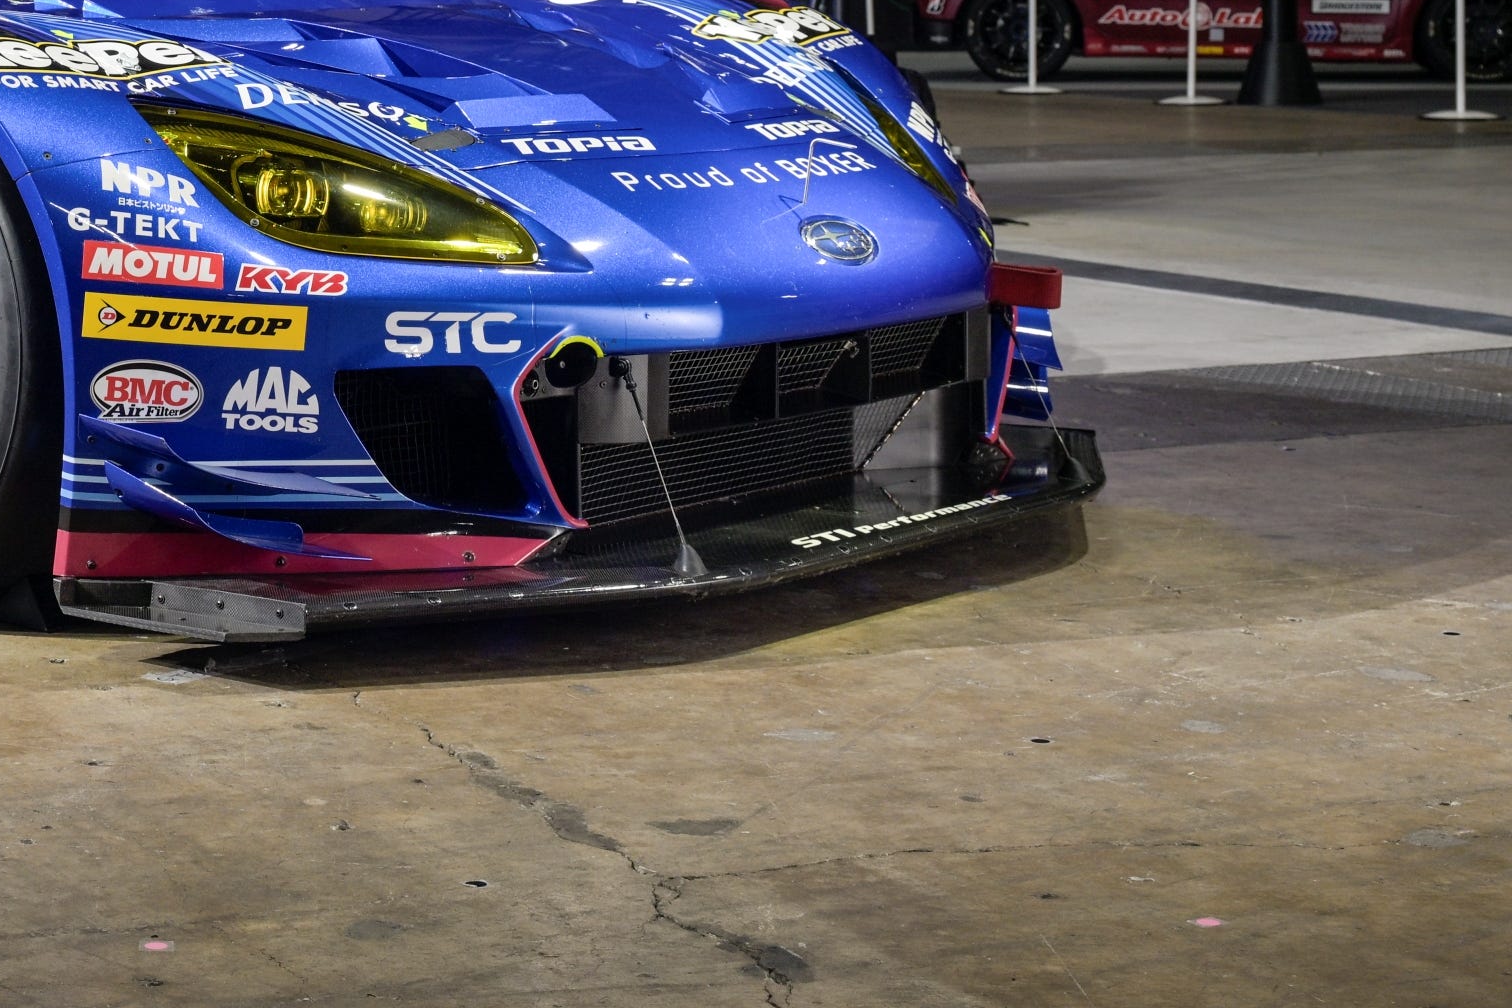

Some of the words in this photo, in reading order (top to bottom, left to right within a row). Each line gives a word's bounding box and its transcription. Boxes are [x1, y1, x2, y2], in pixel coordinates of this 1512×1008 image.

[46, 74, 120, 92] SMART
[128, 74, 180, 93] CAR
[100, 158, 201, 208] NPR
[611, 165, 735, 192] Proud
[741, 160, 781, 182] of
[67, 206, 203, 243] G-TEKT
[87, 246, 217, 285] MOTUL
[236, 265, 348, 296] KYB
[128, 309, 293, 337] DUNLOP
[384, 311, 523, 355] STC
[103, 375, 190, 407] BMC
[222, 366, 320, 415] MAC
[103, 403, 145, 418] Air
[144, 405, 182, 418] Filter
[221, 413, 319, 434] TOOLS
[791, 526, 858, 549] STI
[854, 492, 1013, 536] Performance
